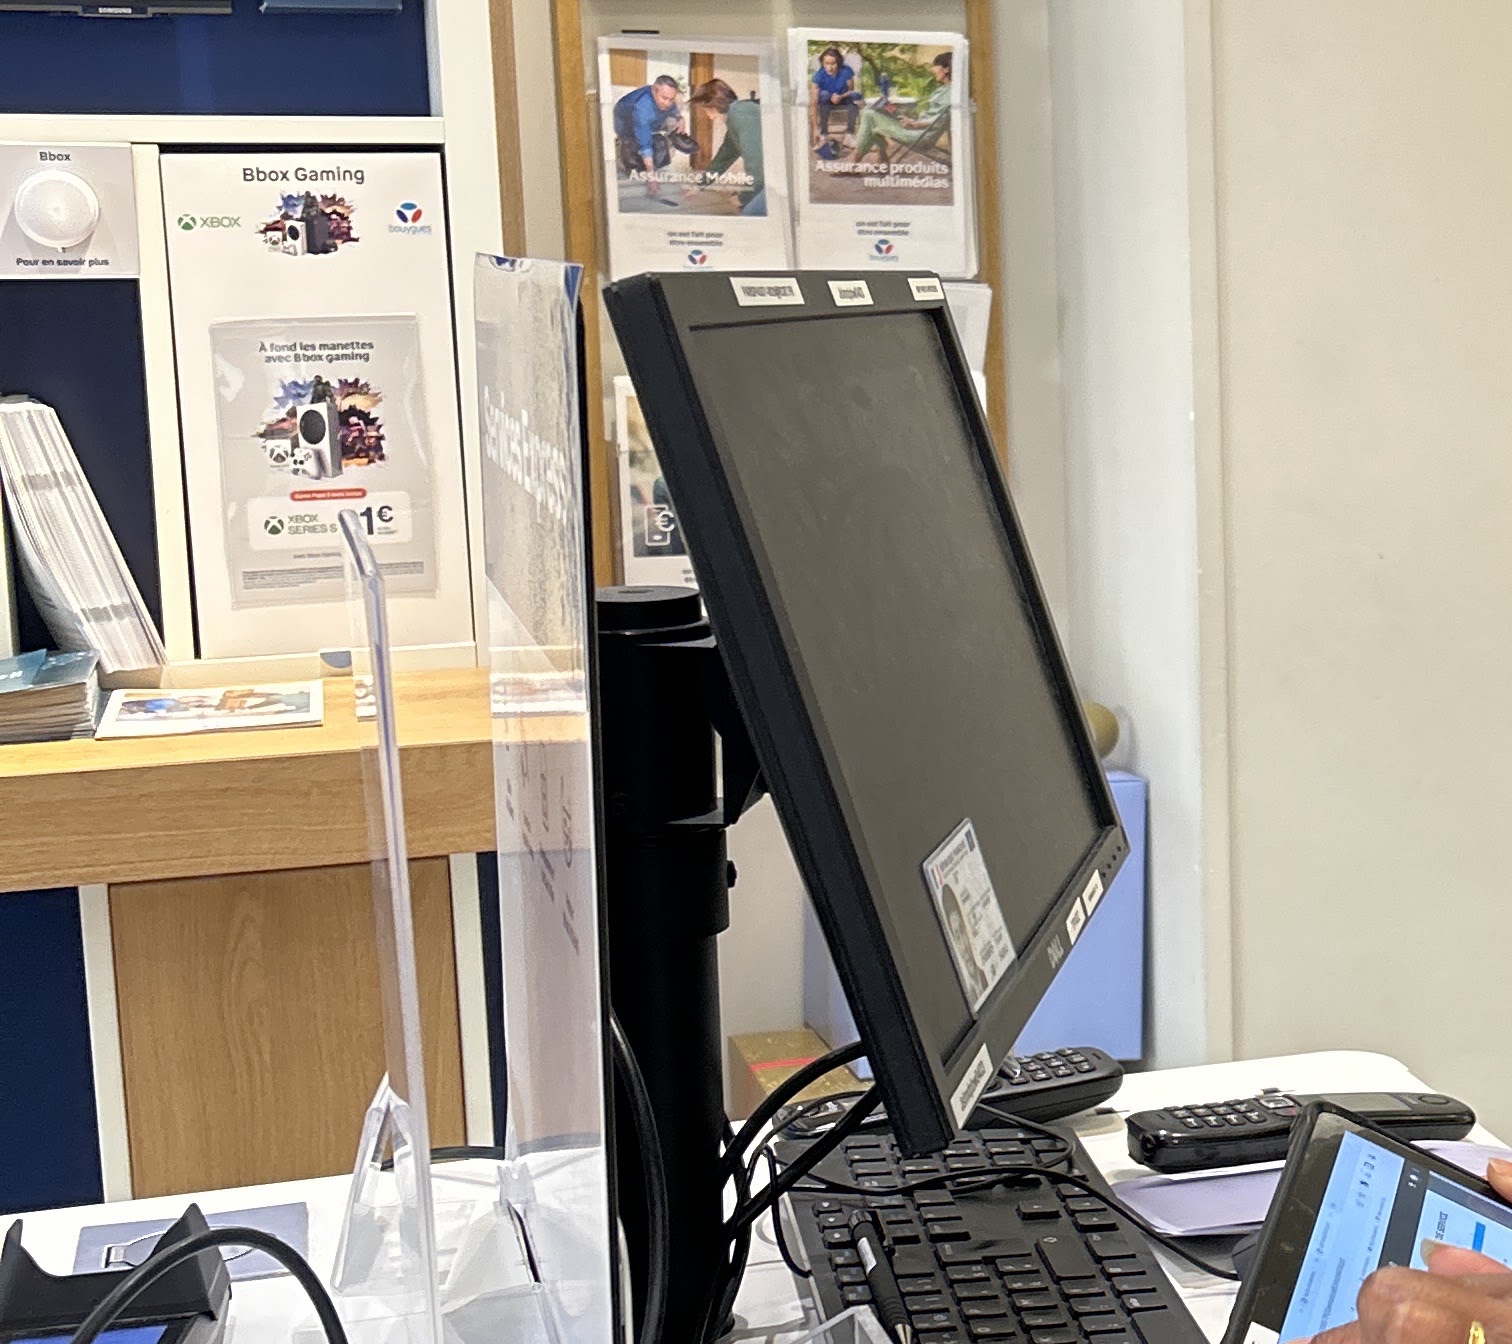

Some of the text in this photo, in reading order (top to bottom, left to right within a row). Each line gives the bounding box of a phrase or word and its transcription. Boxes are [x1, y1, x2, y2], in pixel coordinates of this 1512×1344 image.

[39, 151, 71, 162] Bbox
[815, 160, 949, 176] Assurance produits
[242, 166, 365, 185] Bbox Gaming
[629, 169, 754, 186] Assurance Mobile
[863, 175, 949, 189] multimédias
[200, 216, 241, 229] XBOX
[388, 224, 432, 236] bouygues
[16, 258, 39, 267] Pour
[57, 257, 85, 266] savoir
[88, 258, 109, 267] plus
[258, 341, 374, 353] À fond les manettes
[264, 351, 370, 364] avec Bbox gaming
[288, 514, 318, 523] XBOX
[288, 523, 338, 535] SERIES S
